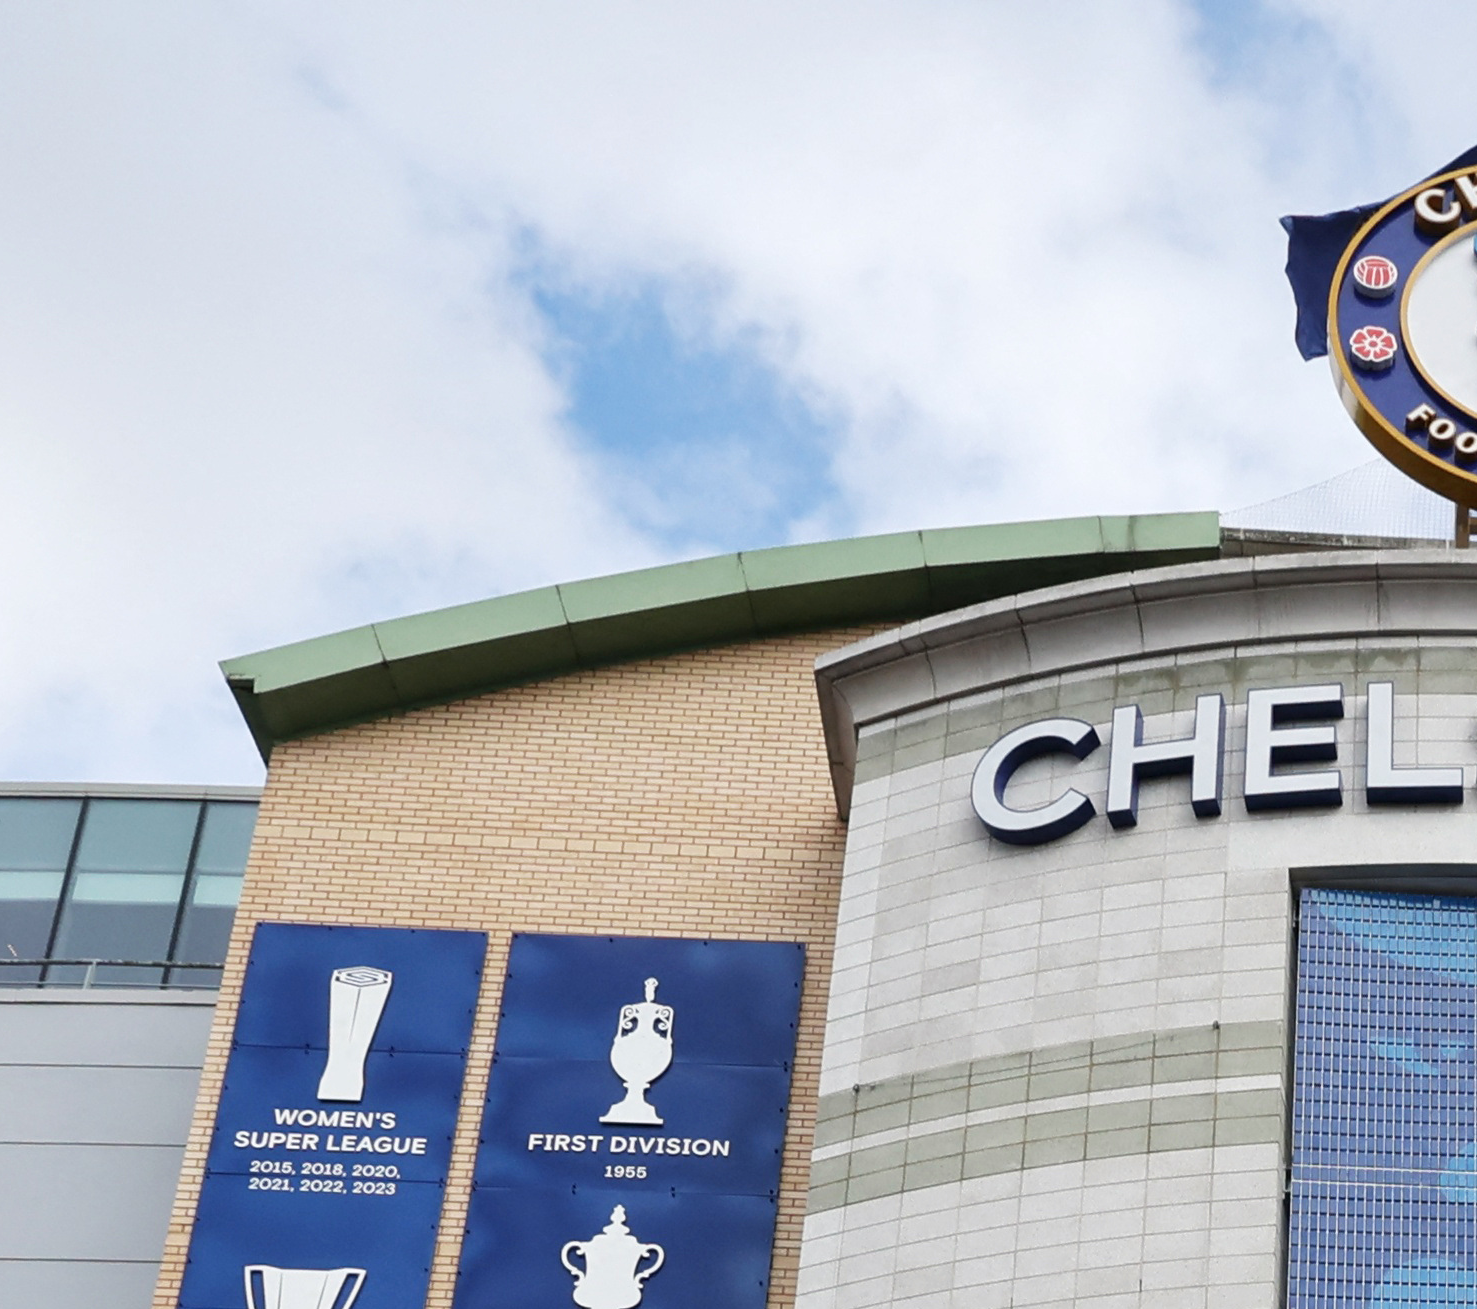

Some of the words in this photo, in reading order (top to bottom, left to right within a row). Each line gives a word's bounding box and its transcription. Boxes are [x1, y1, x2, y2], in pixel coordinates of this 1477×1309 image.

[274, 1108, 396, 1130] WOMEN'S
[233, 1130, 320, 1151] SUPER
[326, 1134, 428, 1155] LEAGUE
[527, 1133, 604, 1152] FIRST
[609, 1135, 730, 1157] DIVISION
[249, 1160, 296, 1175] 2015,
[300, 1161, 347, 1177] 2018,
[351, 1164, 401, 1180] 2020,
[604, 1165, 647, 1179] 1955
[248, 1177, 295, 1193] 2021,
[299, 1178, 347, 1194] 2022,
[351, 1181, 396, 1196] 2023
